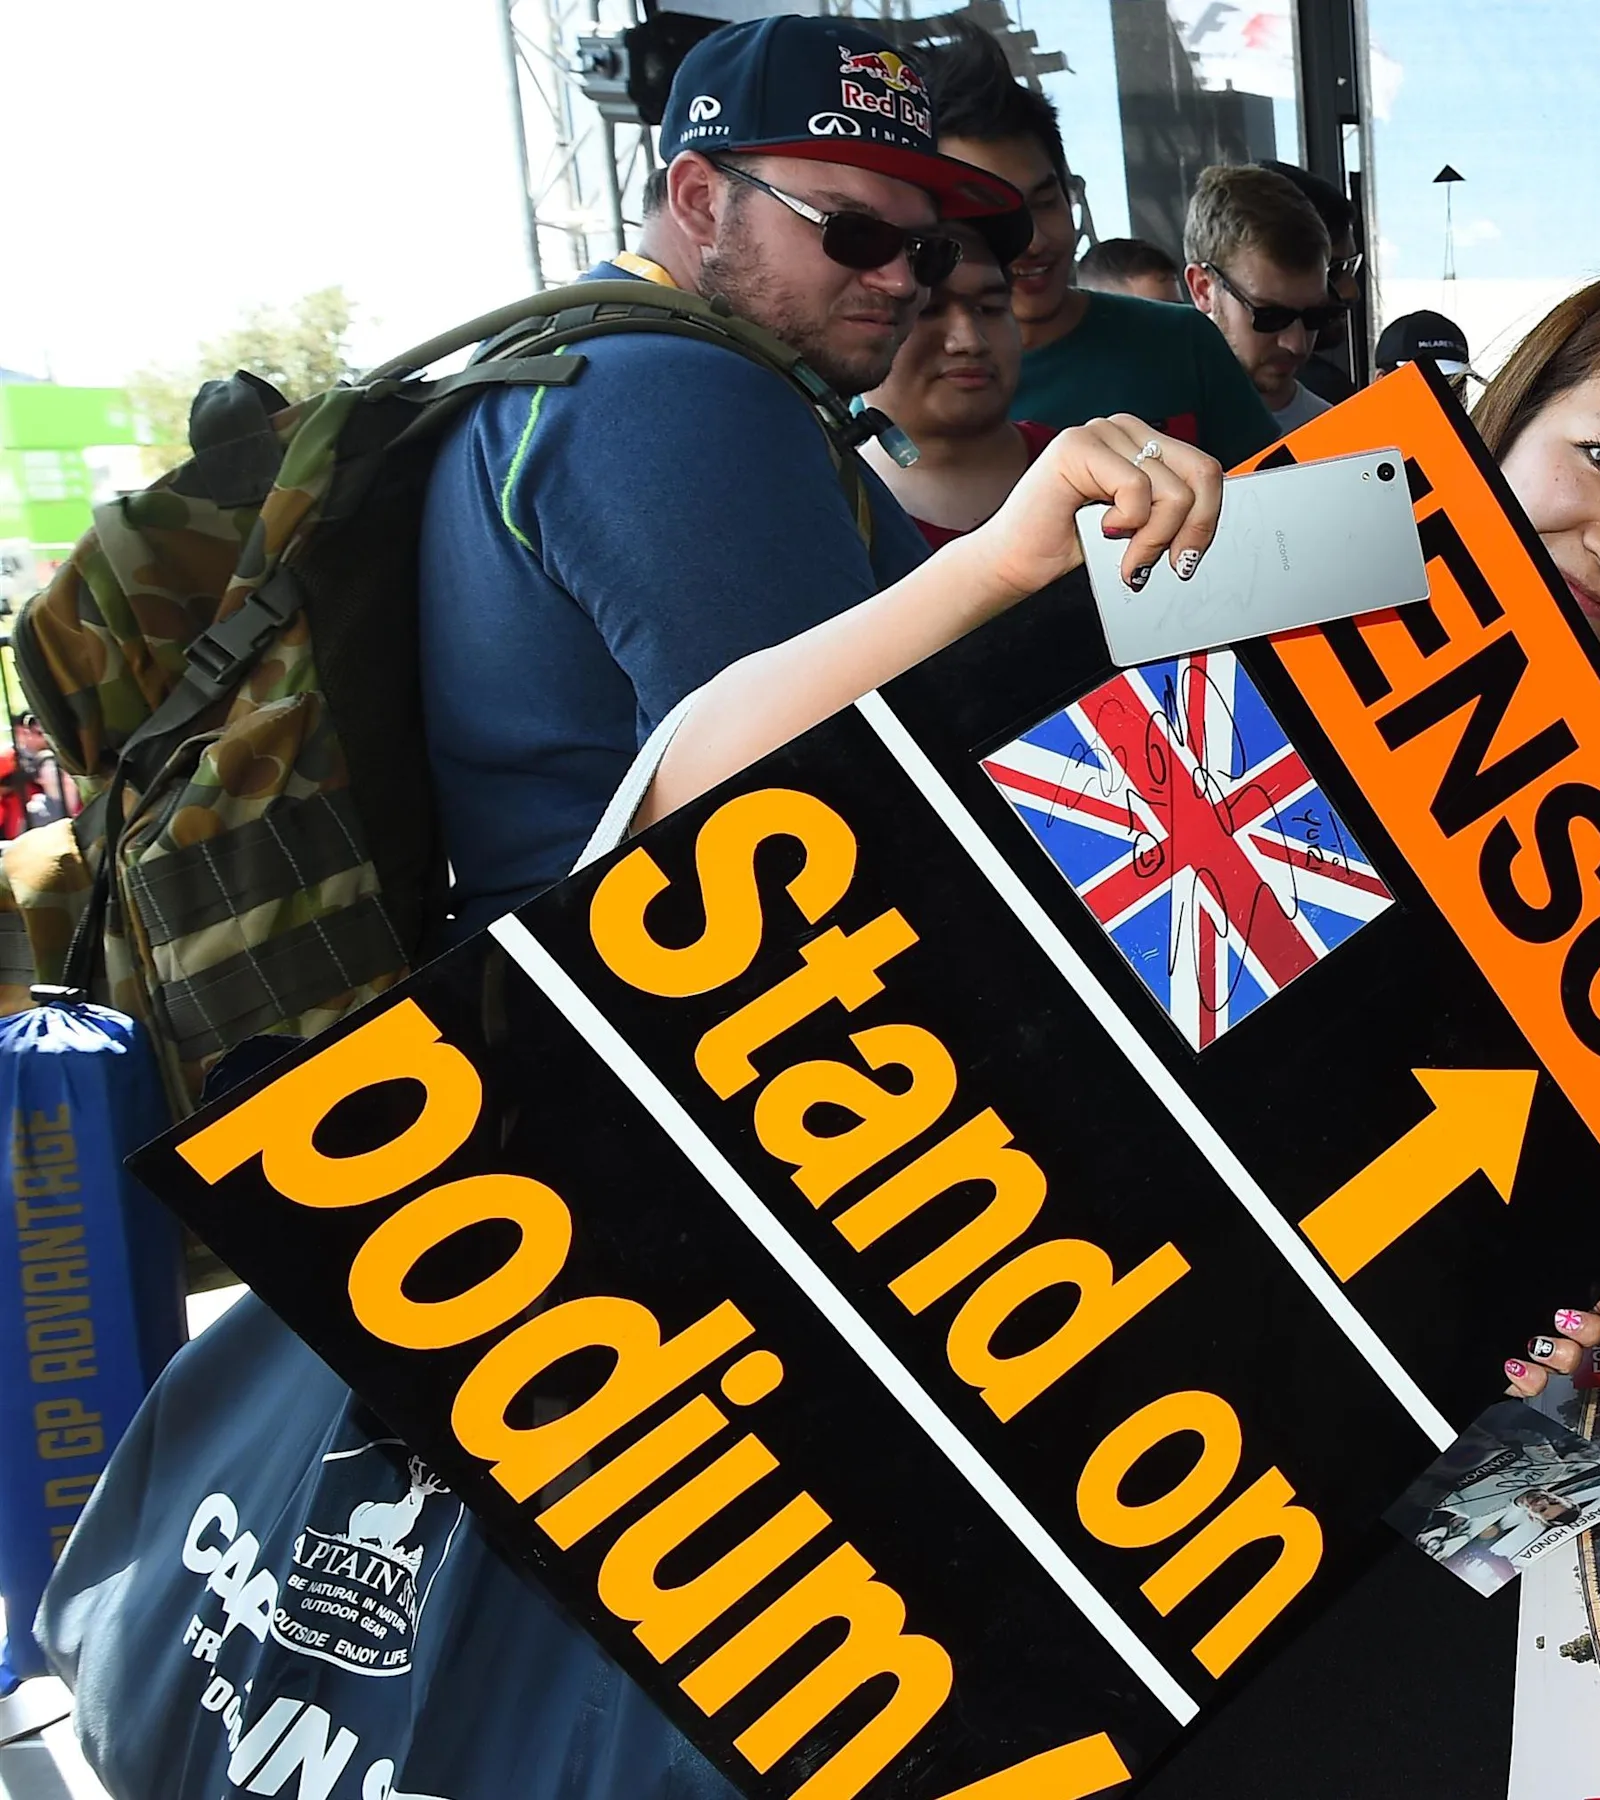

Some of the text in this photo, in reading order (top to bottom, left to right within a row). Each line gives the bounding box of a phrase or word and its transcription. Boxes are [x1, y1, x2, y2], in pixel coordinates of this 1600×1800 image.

[841, 79, 896, 118] Red
[1276, 530, 1290, 571] docomo
[12, 1102, 98, 1384] ADVANTAGE
[589, 788, 1324, 1680] Stand on
[33, 1397, 106, 1460] GP
[1519, 1529, 1568, 1561] HONDA
[287, 1574, 407, 1635] BE NATURAL IN NATURE
[300, 1597, 388, 1640] OUTDOOR GEAR
[273, 1607, 408, 1667] OUTSIDE ENJOY LIFE
